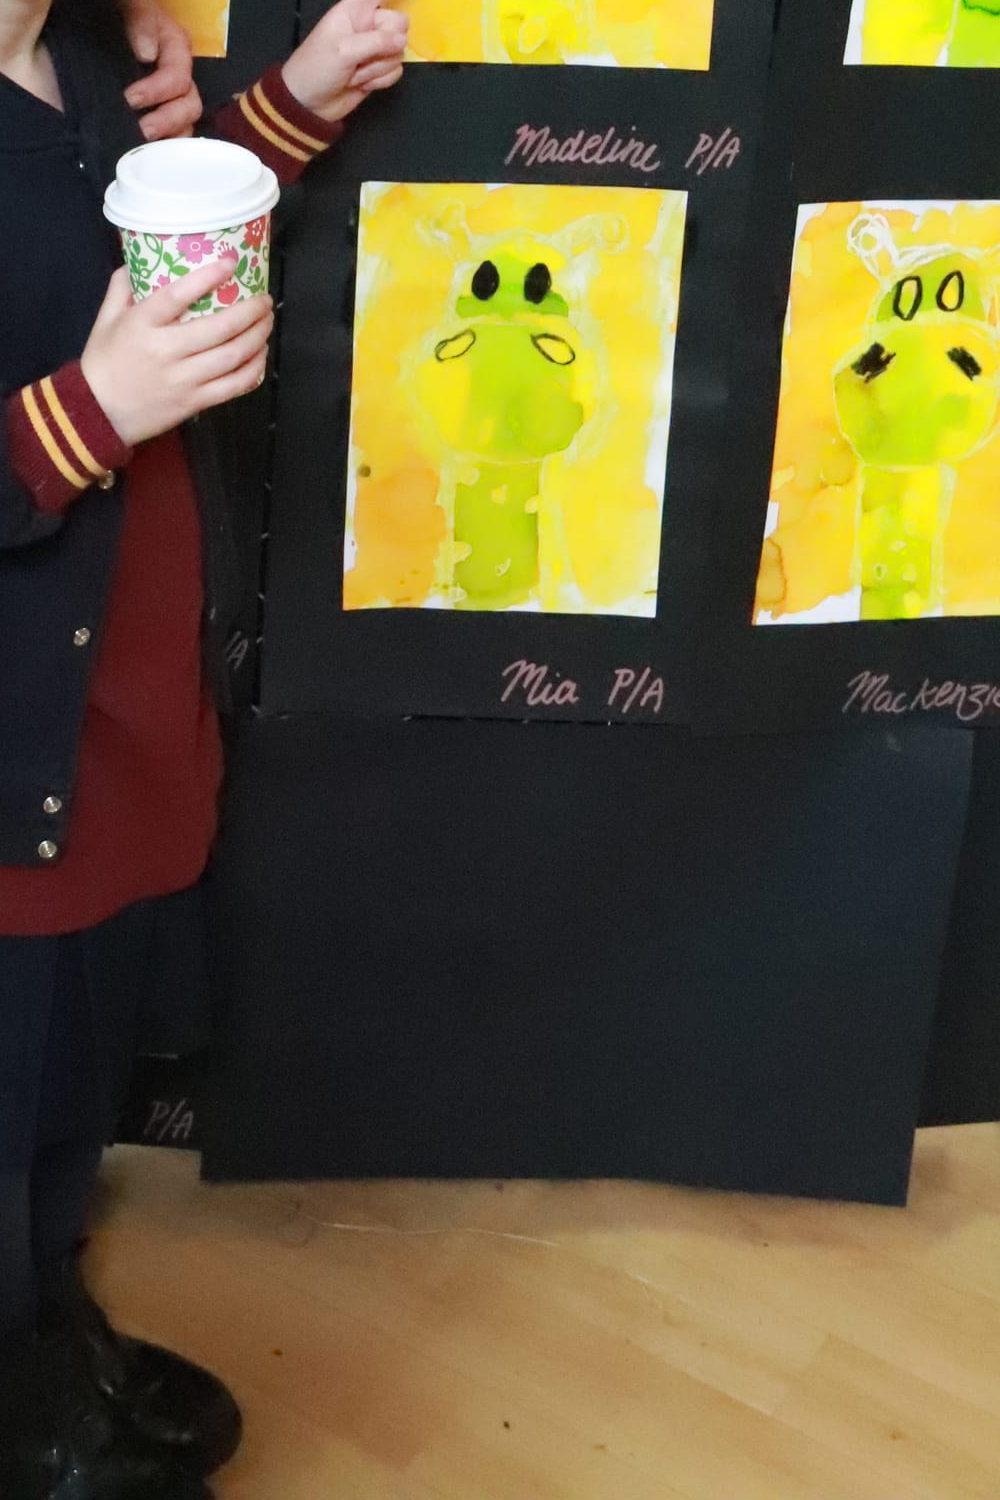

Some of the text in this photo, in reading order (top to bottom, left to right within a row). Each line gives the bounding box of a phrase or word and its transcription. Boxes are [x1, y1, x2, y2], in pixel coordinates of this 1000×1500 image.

[504, 123, 741, 176] Madeline P/A
[501, 659, 666, 713] Mia P/A
[143, 1098, 194, 1141] P/A
